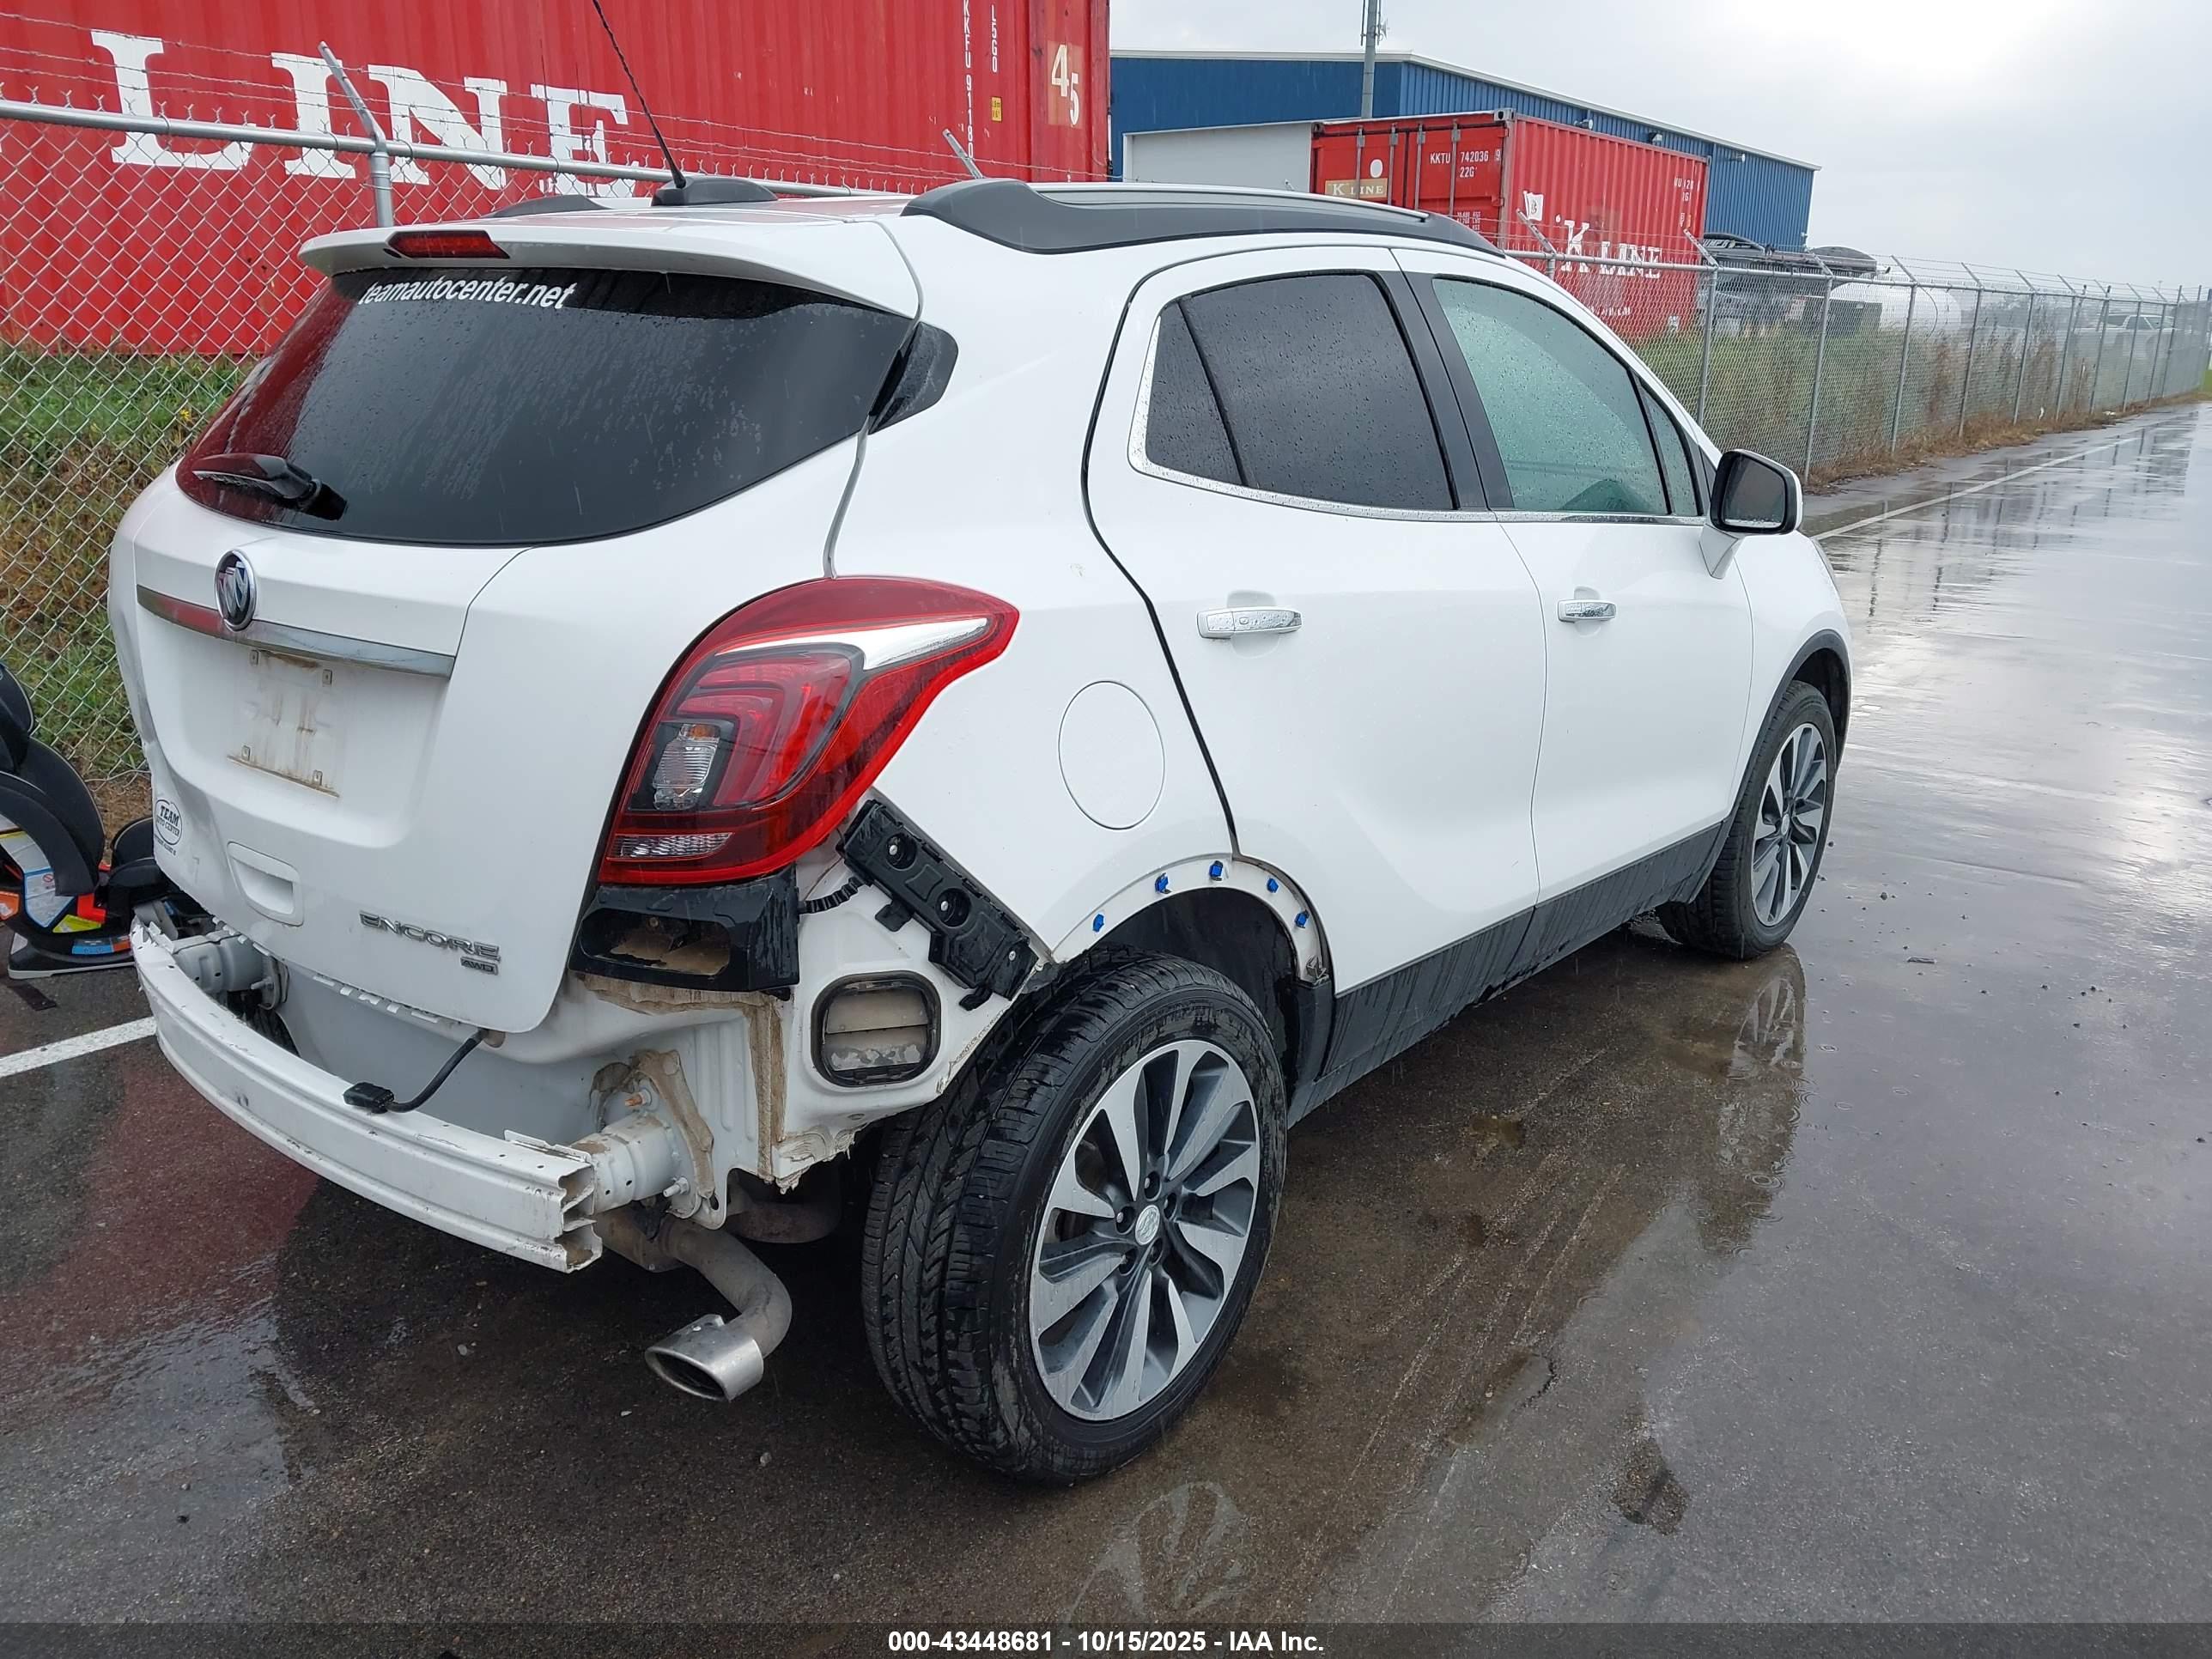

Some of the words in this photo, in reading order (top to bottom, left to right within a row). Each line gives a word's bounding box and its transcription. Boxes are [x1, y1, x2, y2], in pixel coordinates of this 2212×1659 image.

[1051, 44, 1079, 126] 45
[90, 28, 637, 198] LINE
[1430, 152, 1451, 165] KKTU
[1460, 150, 1489, 163] 742036
[358, 275, 578, 309] teamautocenter.net
[160, 805, 179, 827] TEAM
[359, 910, 501, 963] ENCORE
[460, 957, 498, 975] AWD
